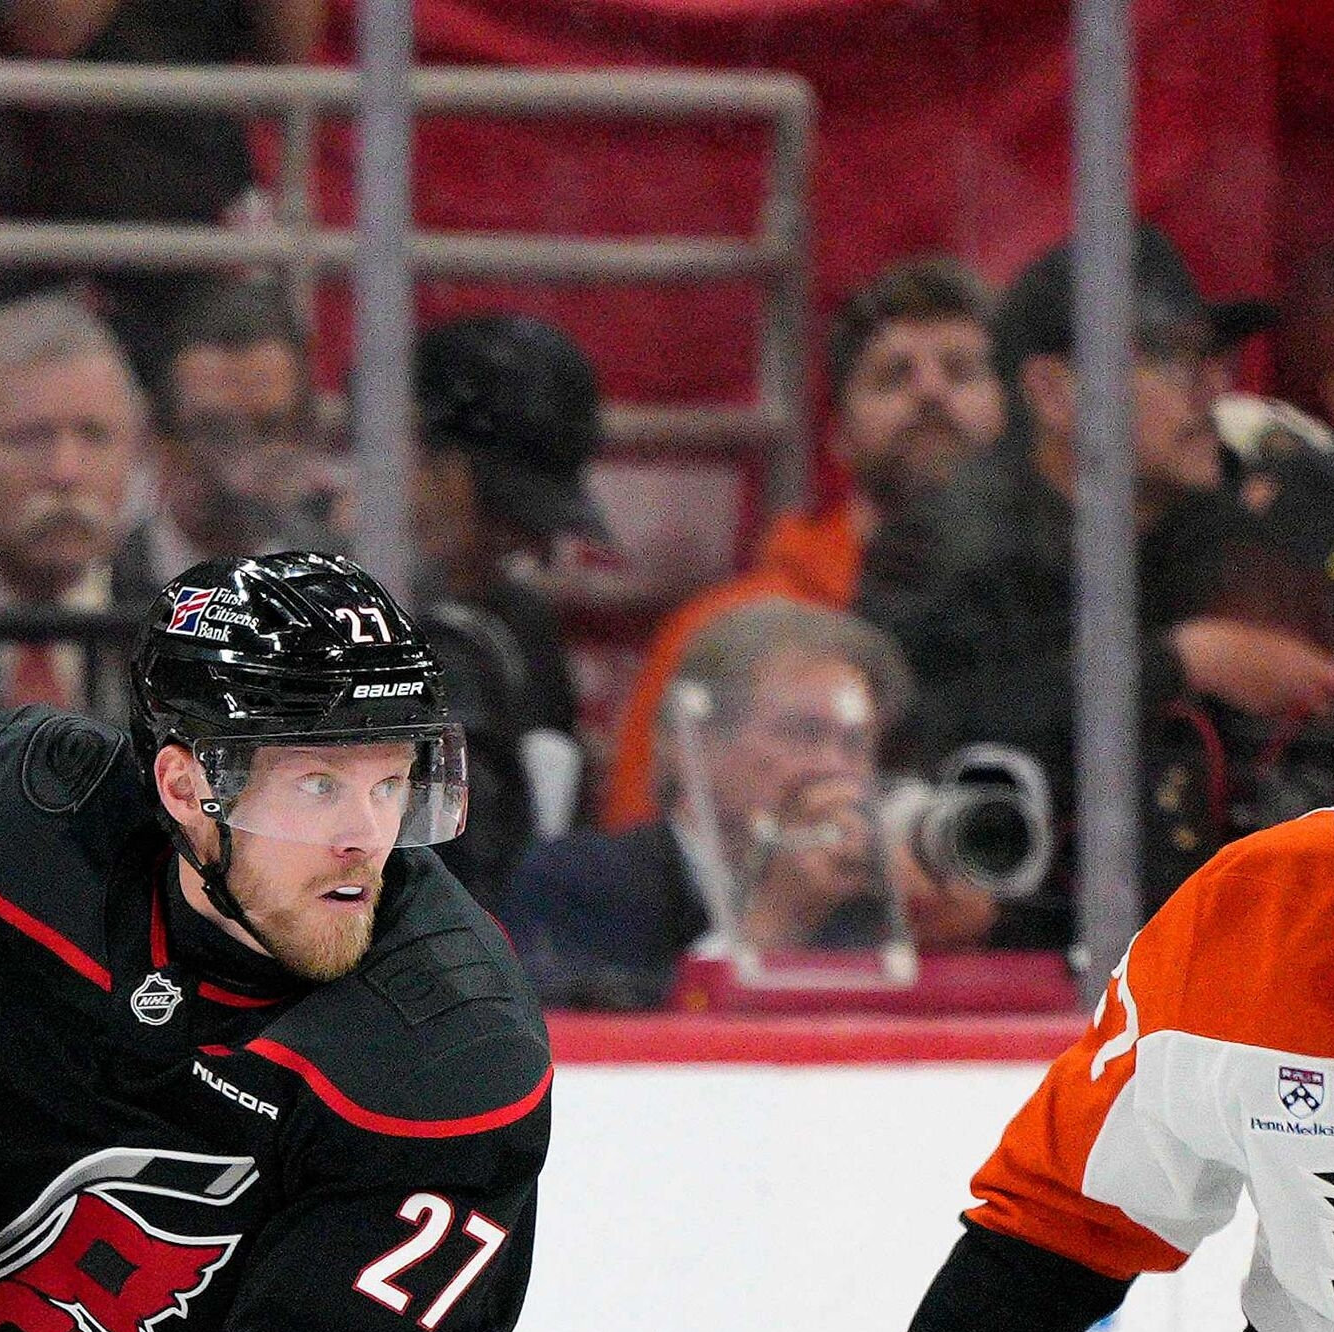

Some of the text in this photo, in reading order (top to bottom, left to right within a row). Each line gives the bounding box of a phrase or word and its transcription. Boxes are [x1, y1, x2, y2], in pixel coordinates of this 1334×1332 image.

[214, 587, 245, 606] First
[204, 603, 259, 628] Citizens
[335, 605, 395, 643] 27
[197, 621, 232, 642] Bank
[353, 681, 424, 699] BAUER
[138, 995, 170, 1006] NHL
[192, 1061, 279, 1121] NUCOR
[1250, 1117, 1285, 1132] Penn
[352, 1191, 509, 1332] 27
